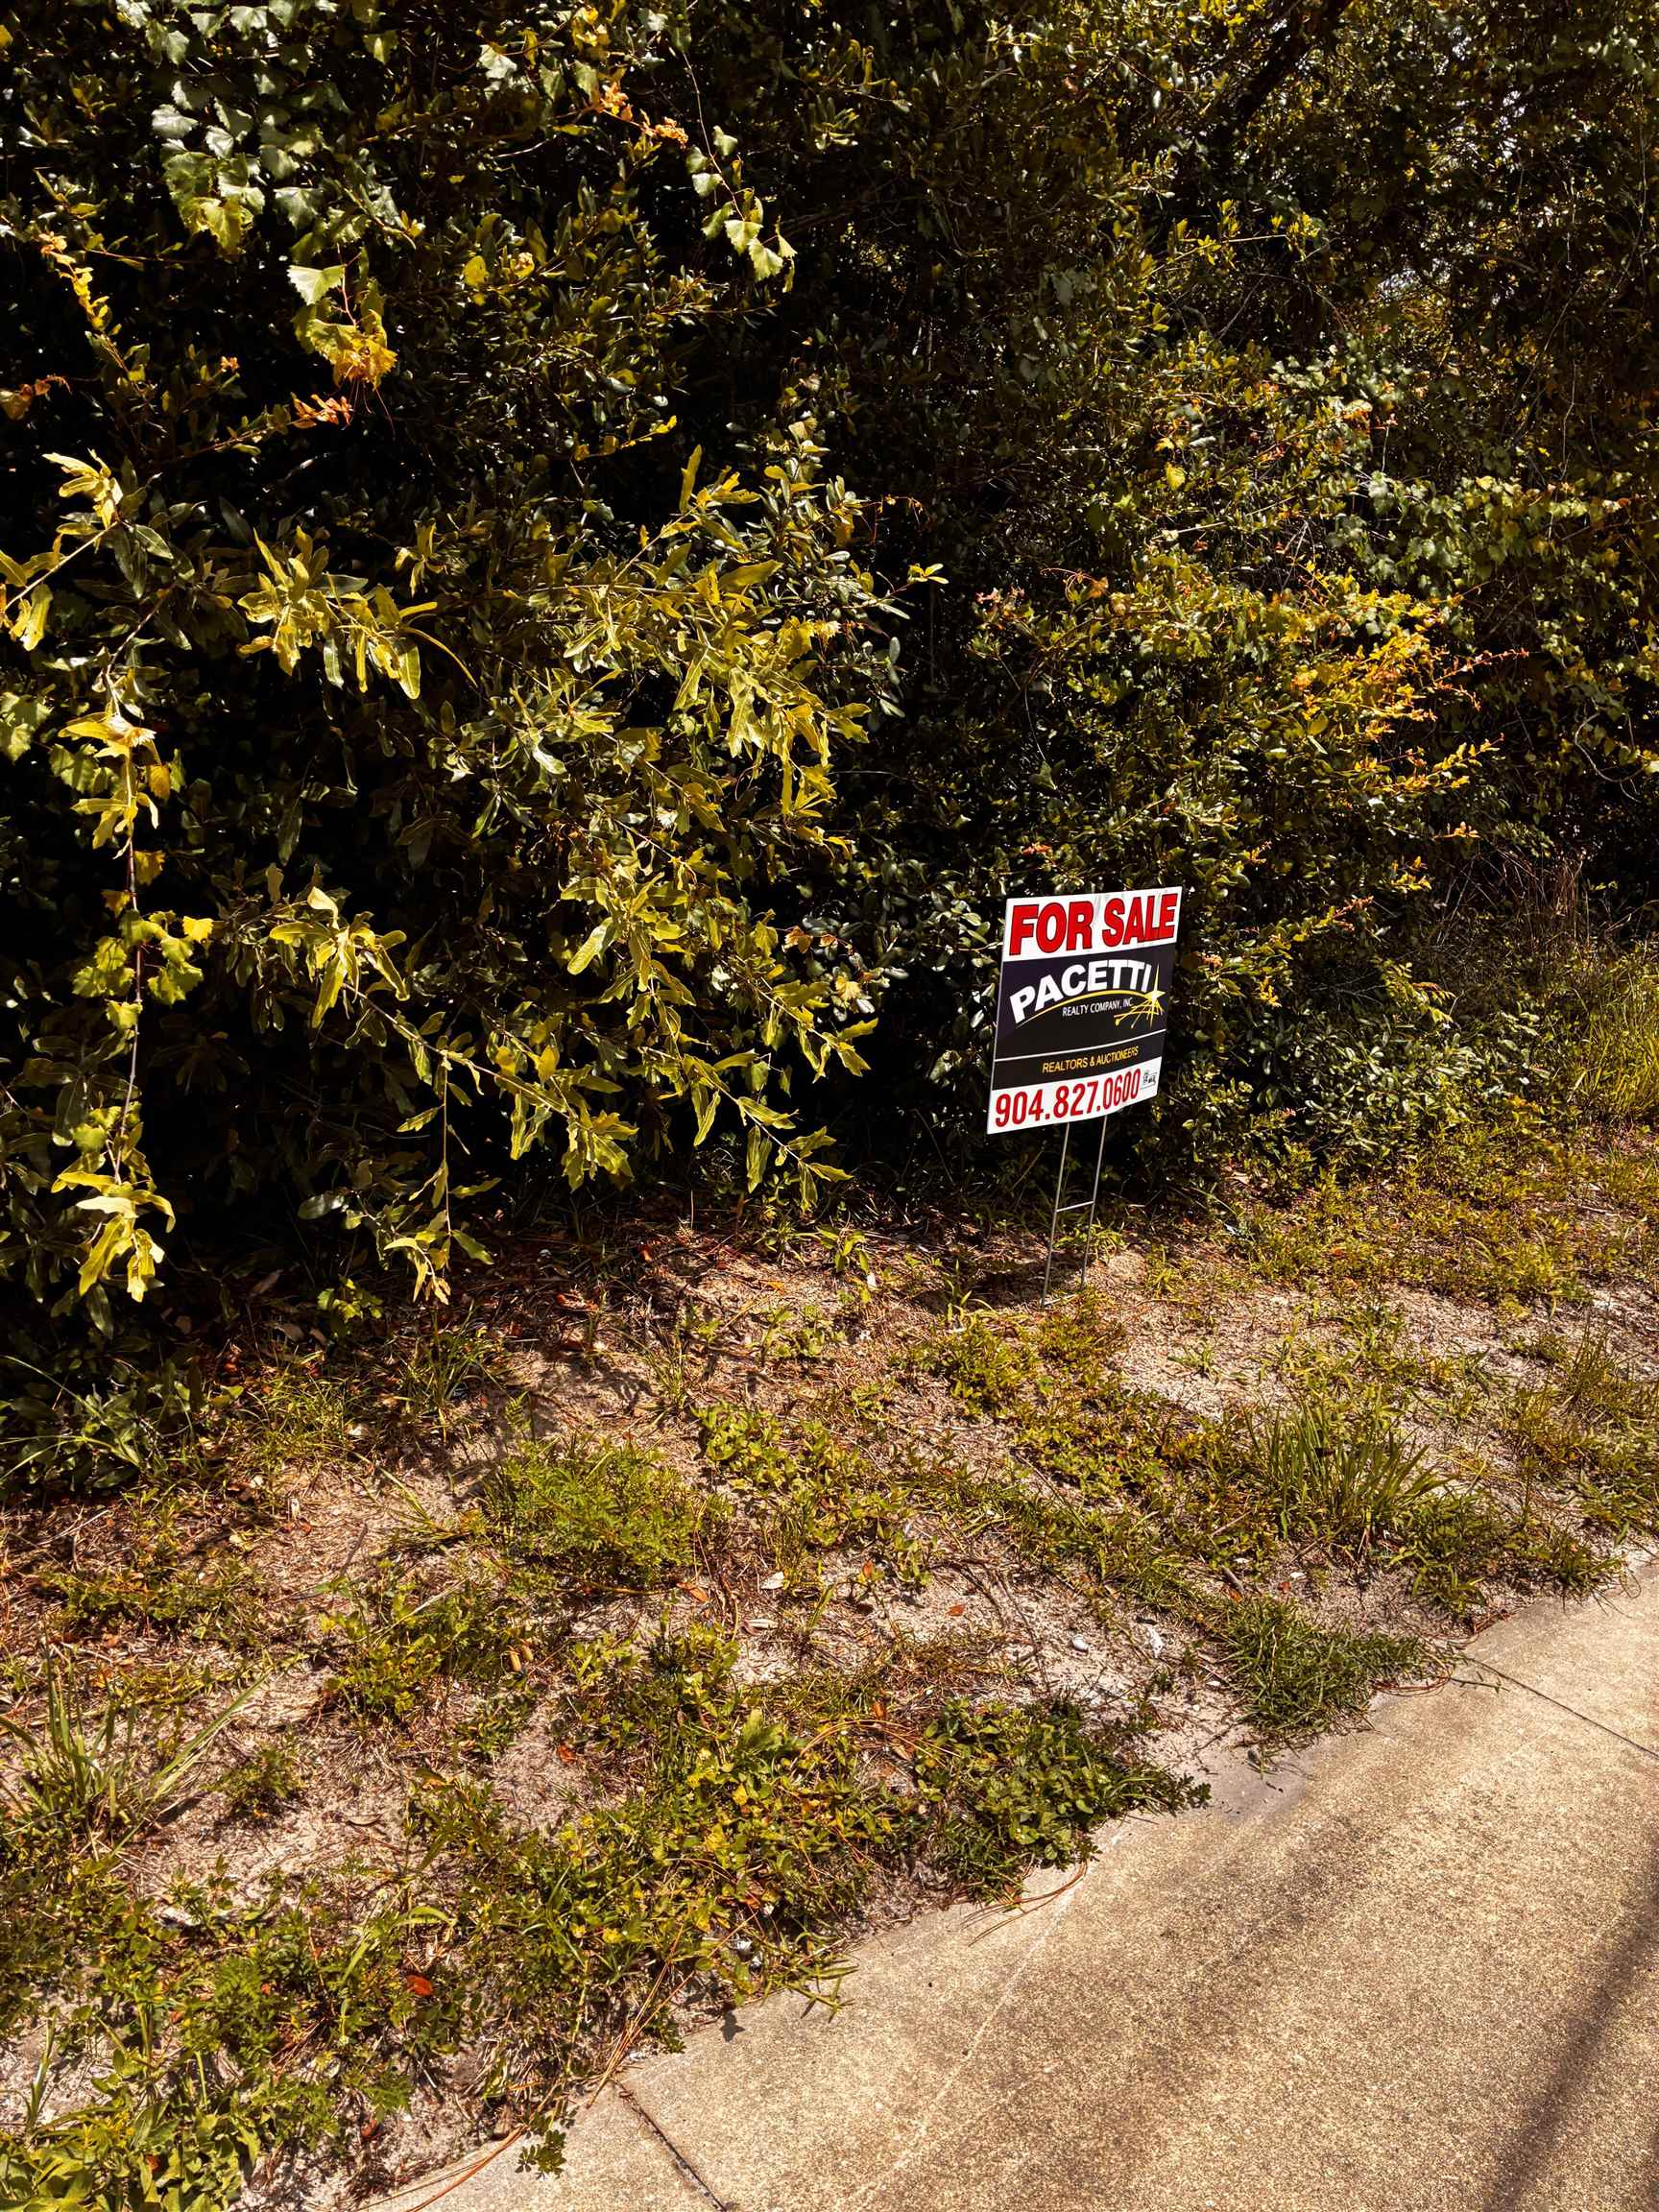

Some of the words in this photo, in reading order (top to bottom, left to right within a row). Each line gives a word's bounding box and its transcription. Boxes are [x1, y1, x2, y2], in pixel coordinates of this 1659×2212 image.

[1009, 902, 1094, 955] FOR
[1102, 894, 1178, 948] SALE
[1010, 959, 1152, 1023] PACETTI
[1062, 1004, 1089, 1017] REALTY
[1043, 1058, 1089, 1073] REALTORS
[1090, 1056, 1095, 1067] &
[1096, 1046, 1139, 1066] AUCTIONEERS
[996, 1068, 1142, 1127] 904.827.0600
